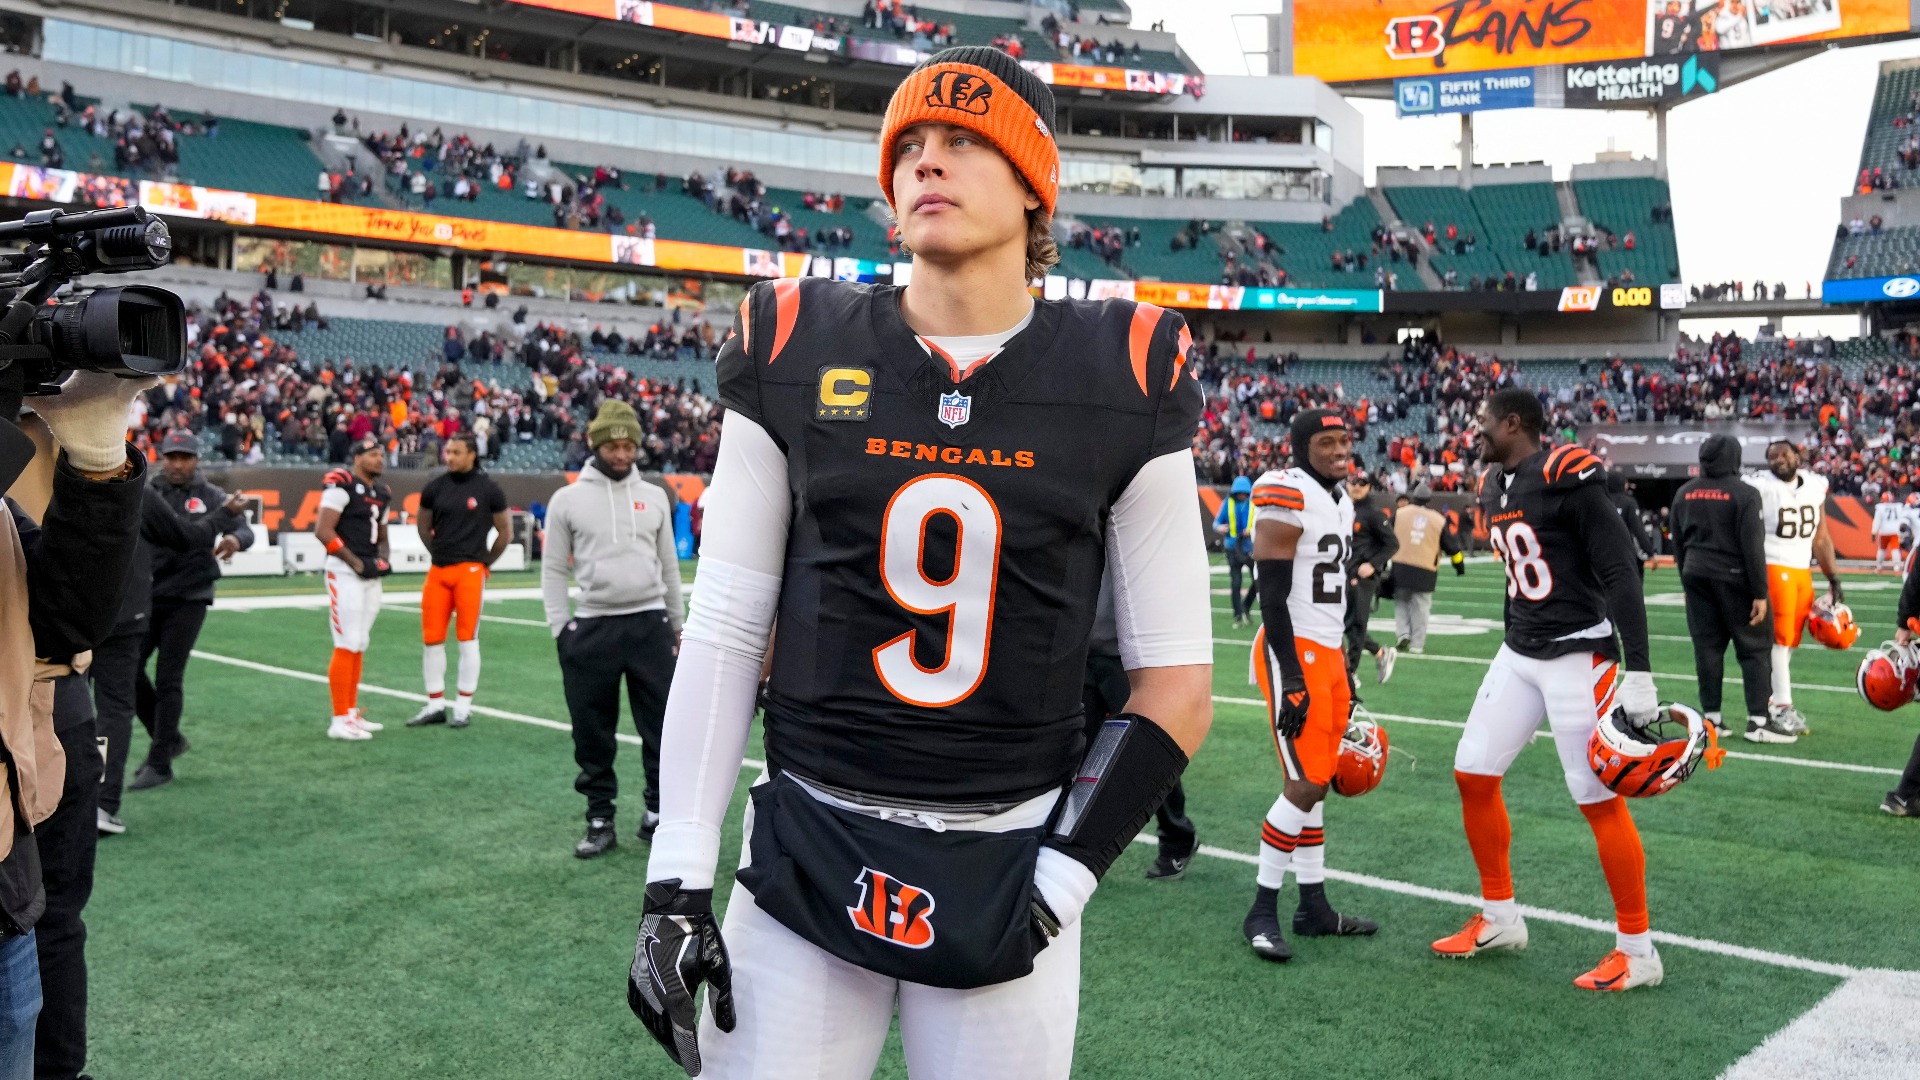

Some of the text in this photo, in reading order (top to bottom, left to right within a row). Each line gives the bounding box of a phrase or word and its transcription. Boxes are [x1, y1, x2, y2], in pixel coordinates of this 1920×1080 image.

[1567, 61, 1679, 89] Kettering
[1440, 76, 1531, 94] FIFTH THIRD
[1597, 82, 1664, 101] HEALTH
[1440, 93, 1481, 107] BANK
[155, 236, 167, 246] JVC
[1612, 287, 1651, 306] 0:00
[820, 368, 871, 407] C
[943, 406, 965, 420] NFL
[865, 437, 1035, 468] BENGALS
[1776, 504, 1816, 539] 68
[1885, 507, 1898, 520] 71
[872, 473, 1002, 708] 9
